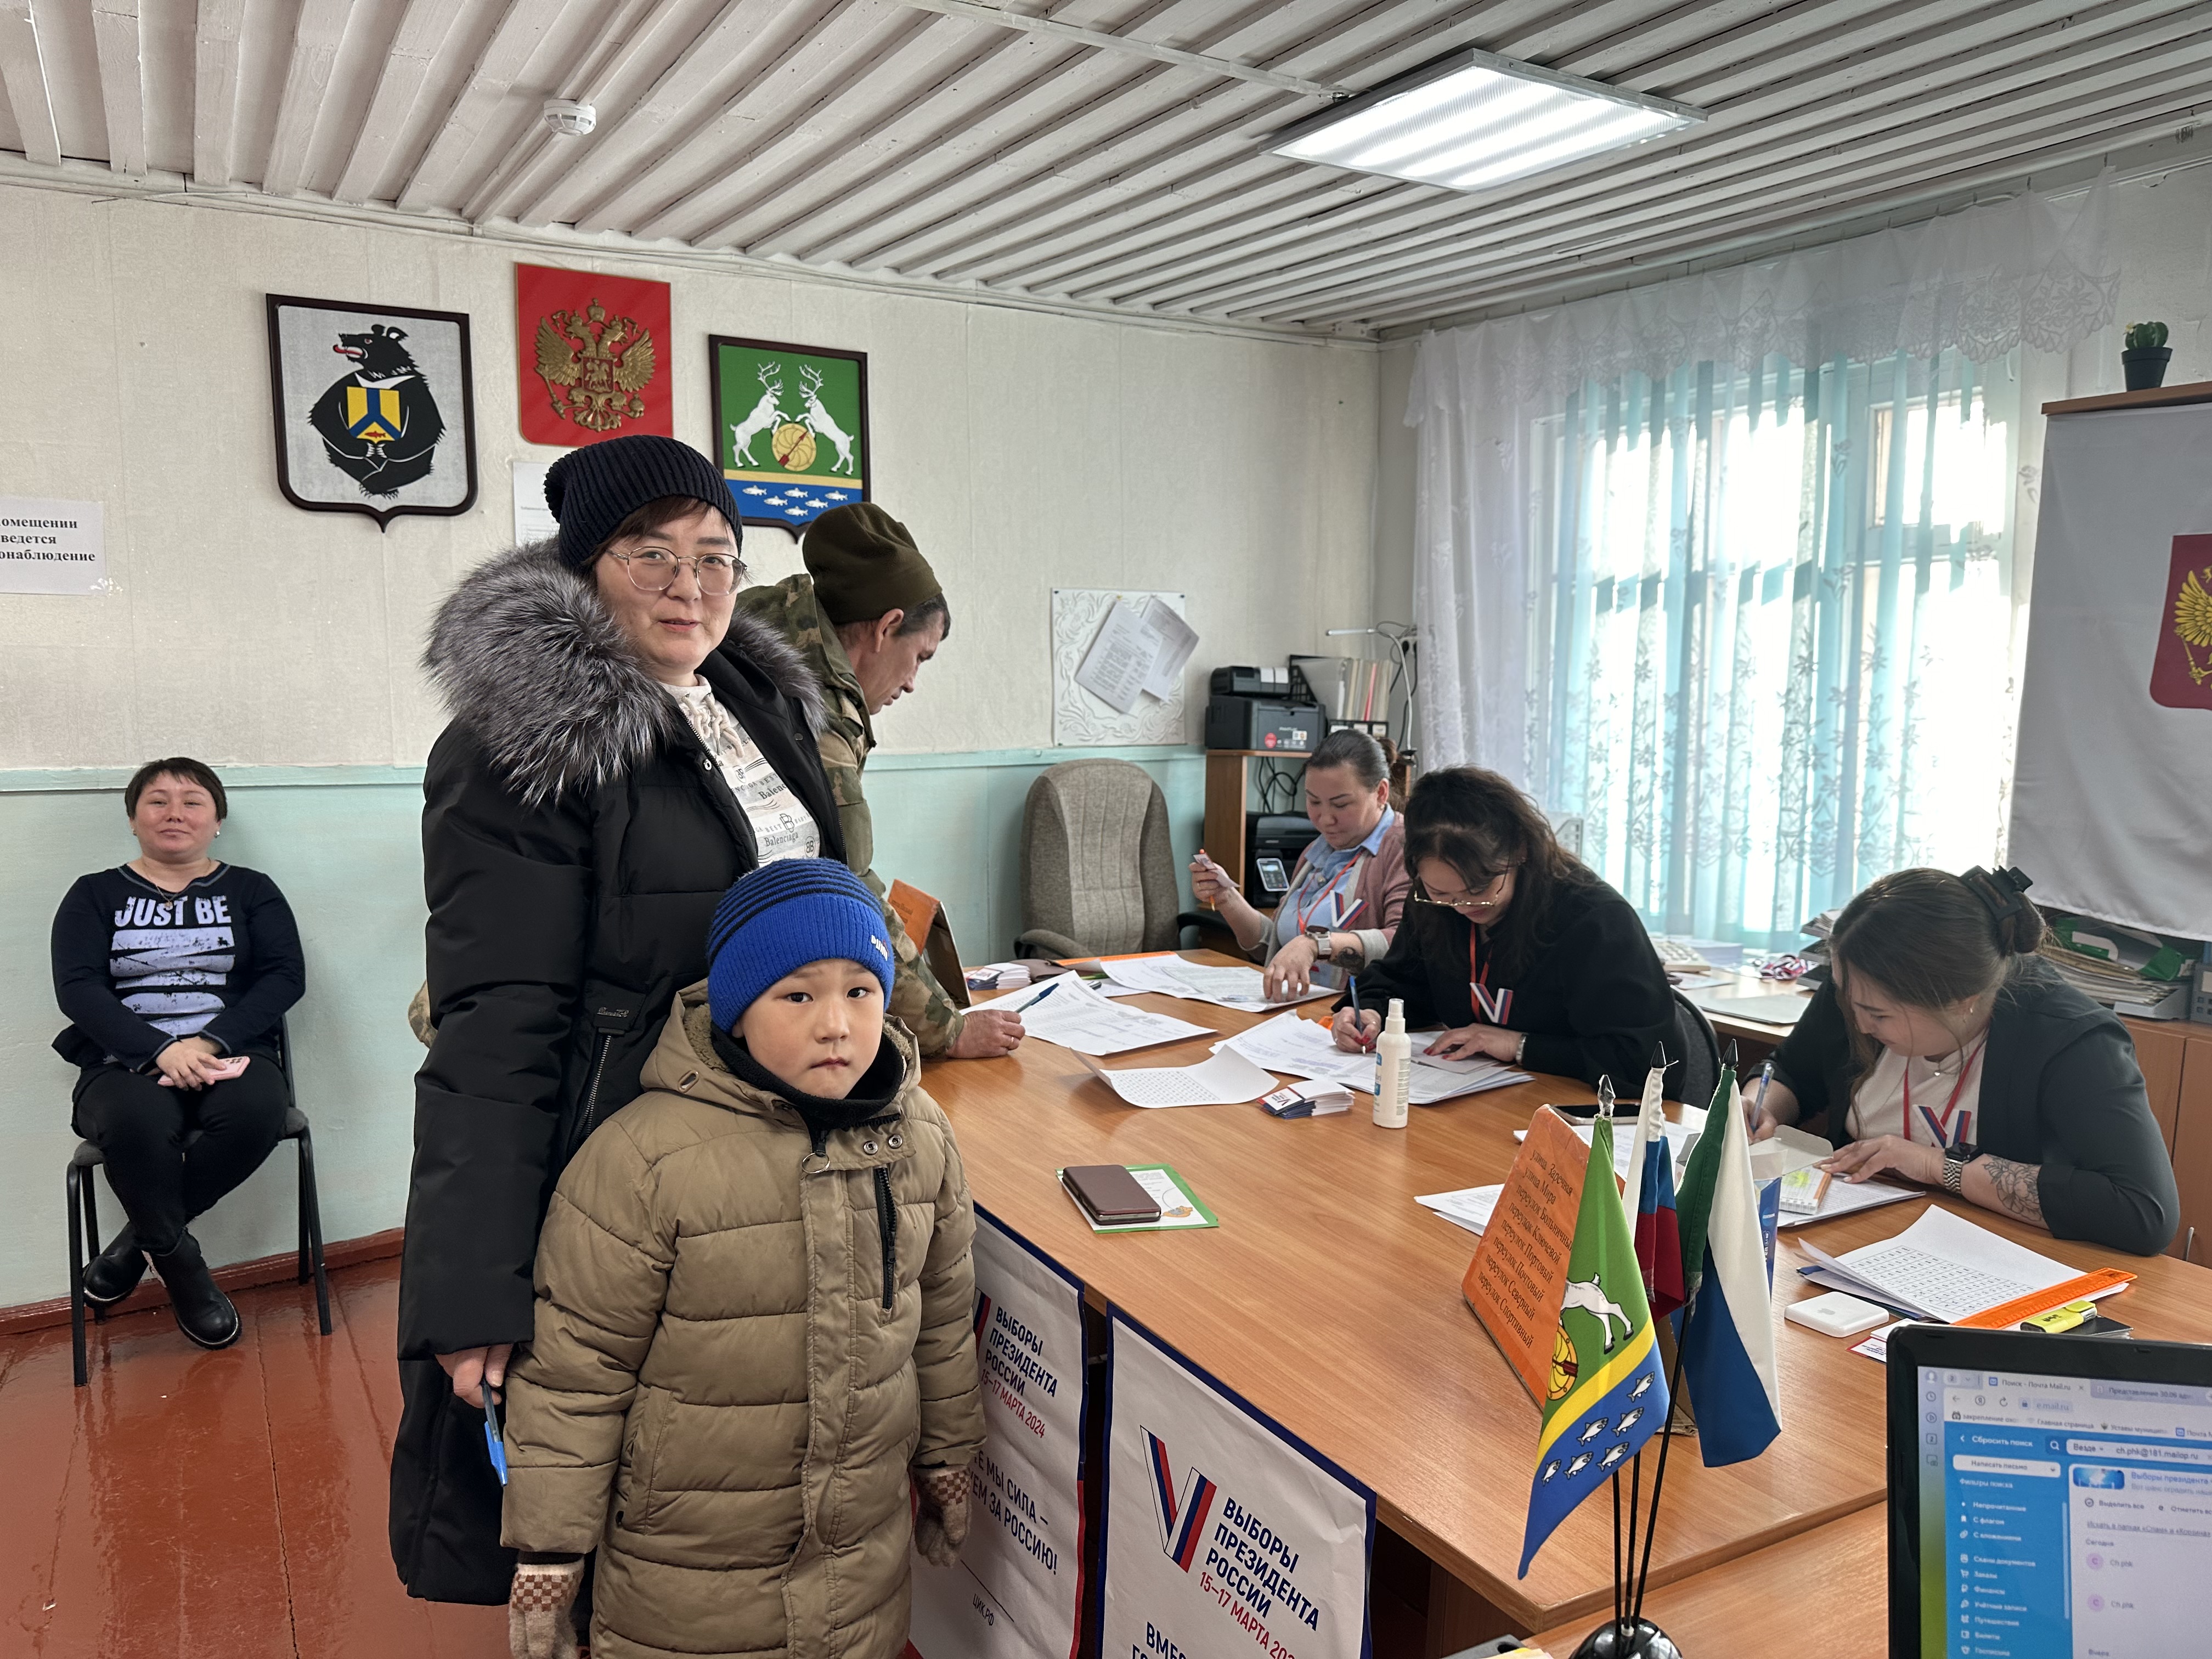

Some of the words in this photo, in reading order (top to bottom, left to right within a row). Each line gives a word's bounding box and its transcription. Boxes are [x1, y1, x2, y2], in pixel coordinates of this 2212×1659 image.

[0, 518, 77, 528] омещении
[1, 534, 57, 544] ведется
[764, 832, 798, 847] Balenciaga
[114, 895, 188, 927] JUST
[195, 895, 232, 925] BE
[1522, 1167, 1541, 1189] улица
[1540, 1180, 1556, 1205] Мира
[1530, 1149, 1548, 1171] улица
[1548, 1163, 1573, 1197] Заречная
[1509, 1202, 1533, 1234] переулок
[1532, 1224, 1562, 1265] Ключевой
[1516, 1184, 1542, 1216] переулок
[1540, 1207, 1572, 1251] Больничны
[1493, 1237, 1517, 1270] переулок
[1515, 1261, 1545, 1303] Почтовый
[1501, 1219, 1526, 1253] переулок
[1524, 1244, 1554, 1284] Портовый
[1478, 1271, 1502, 1306] переулок
[1499, 1298, 1534, 1349] Спортивный
[1485, 1254, 1510, 1288] переулок
[1508, 1280, 1536, 1322] Северный
[996, 1306, 1043, 1357] ВЫБОРЫ
[985, 1348, 1025, 1396] РОССИИ
[989, 1327, 1058, 1397] ПРЕЗИДЕНТА
[2002, 1379, 2023, 1387] Поиск
[2028, 1381, 2048, 1389] Почта
[2050, 1383, 2071, 1391] Mail.ru
[1000, 1386, 1025, 1421] МАРТА
[1025, 1411, 1046, 1438] 2024
[2036, 1403, 2069, 1411] e.mail.ru
[2037, 1419, 2063, 1427] Главная
[2064, 1421, 2094, 1430] страница
[1972, 1436, 2009, 1445] Сбросить
[1972, 1460, 2002, 1469] Написать
[2073, 1443, 2096, 1452] Везде
[987, 1457, 1004, 1492] МЫ
[1007, 1478, 1037, 1523] СИЛА
[2131, 1471, 2162, 1481] Выборы
[2164, 1475, 2208, 1485] президента
[2099, 1500, 2131, 1509] Выделить
[2171, 1506, 2203, 1514] Отметить
[989, 1492, 1001, 1522] ЗА
[1004, 1506, 1058, 1575] РОССИЮ!
[1223, 1497, 1300, 1574] ВЫБОРЫ
[2086, 1538, 2114, 1547] Сегодня
[1205, 1547, 1272, 1619] РОССИИ
[1214, 1522, 1319, 1632] ПРЕЗИДЕНТА
[972, 1593, 995, 1626] ЦИК.РФ
[1230, 1600, 1270, 1650] МАРТА
